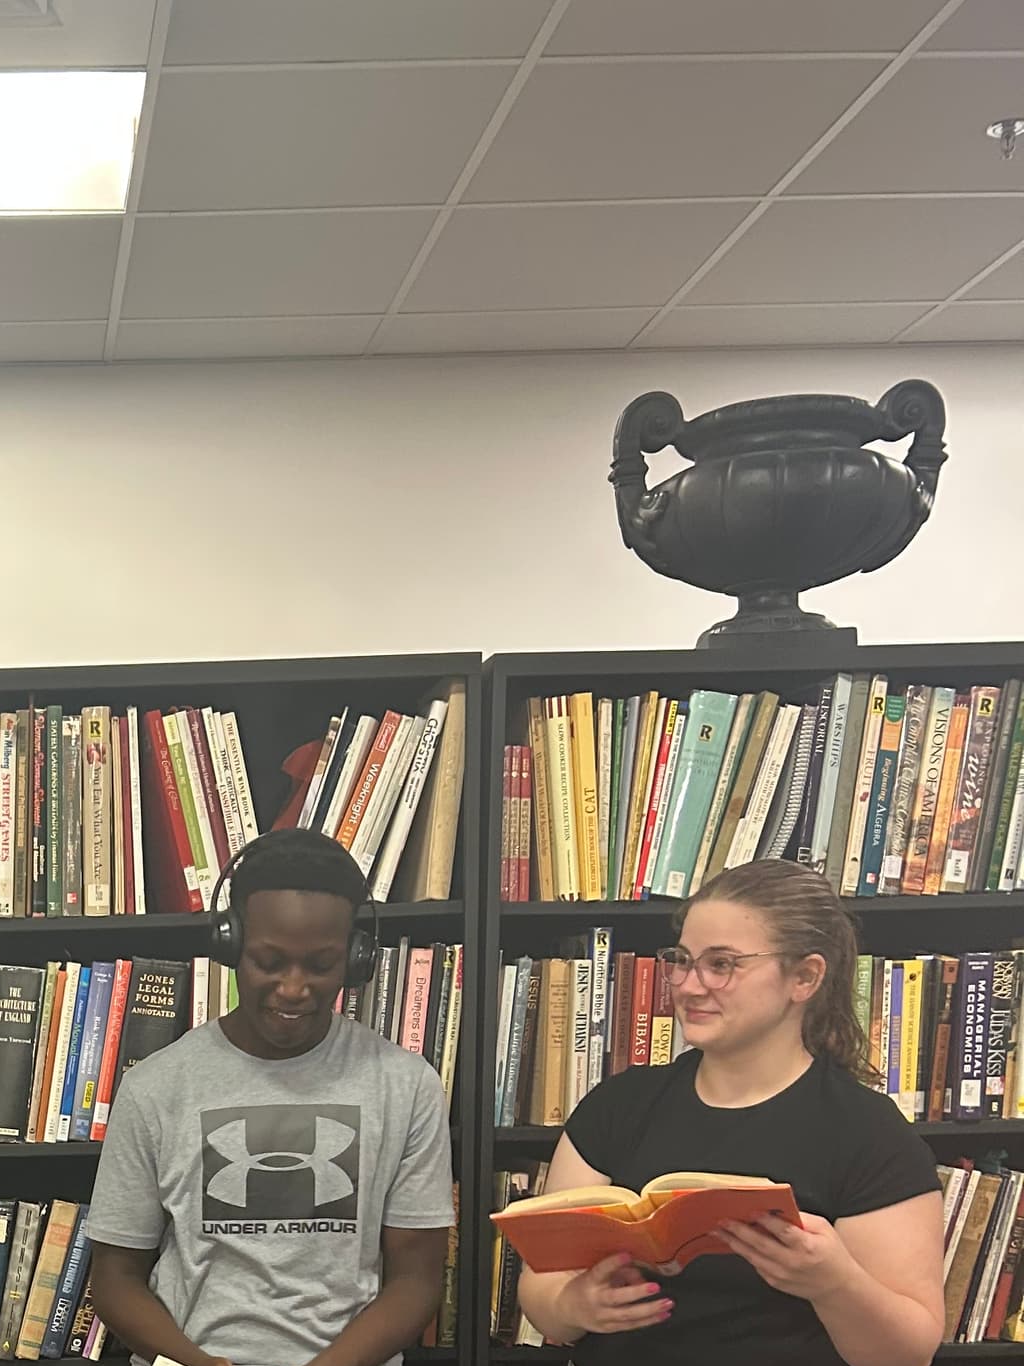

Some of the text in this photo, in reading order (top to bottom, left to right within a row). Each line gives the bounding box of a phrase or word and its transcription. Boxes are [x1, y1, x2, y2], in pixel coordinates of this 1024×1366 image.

[874, 698, 884, 710] R
[980, 698, 992, 712] R
[90, 722, 100, 735] R
[700, 724, 713, 739] R
[815, 704, 829, 753] ESCORIAL
[830, 703, 846, 767] WARSHIPS
[0, 740, 13, 769] Milberg
[226, 722, 250, 817] THE ESSENTIAL WINE BOOK
[219, 749, 239, 815] THINK CRITICALLY
[347, 762, 381, 826] Weeknight
[914, 707, 950, 857] VISIONS OF AMERICA
[960, 753, 981, 822] wine
[584, 787, 596, 813] CAT
[872, 758, 892, 846] Beginning ALGEBRA
[92, 766, 103, 880] You Eat What You Are
[597, 933, 607, 946] R
[9, 987, 22, 997] THE
[138, 984, 175, 996] LEGAL
[140, 973, 175, 985] JONES
[528, 975, 541, 1010] Jesus
[594, 949, 606, 1017] Nutrition Bible
[1002, 961, 1014, 999] NORMAN
[131, 1006, 176, 1018] ANNOTATED
[135, 994, 174, 1006] FORMS
[410, 977, 426, 1043] Dreamers of
[575, 963, 590, 1053] JESUS JUDAISM
[4, 1012, 32, 1023] ENGLAND
[635, 1013, 648, 1056] BIBA'S
[963, 985, 975, 1073] ECONOMICS
[973, 980, 986, 1077] MANAGERIAL
[70, 1023, 81, 1056] Manual
[659, 1023, 671, 1047] SLOW
[987, 1008, 1011, 1076] JUDAS KISS
[84, 1082, 93, 1104] USED
[202, 1222, 357, 1234] UNDER ARMOUR
[51, 1298, 65, 1332] LUDLUM
